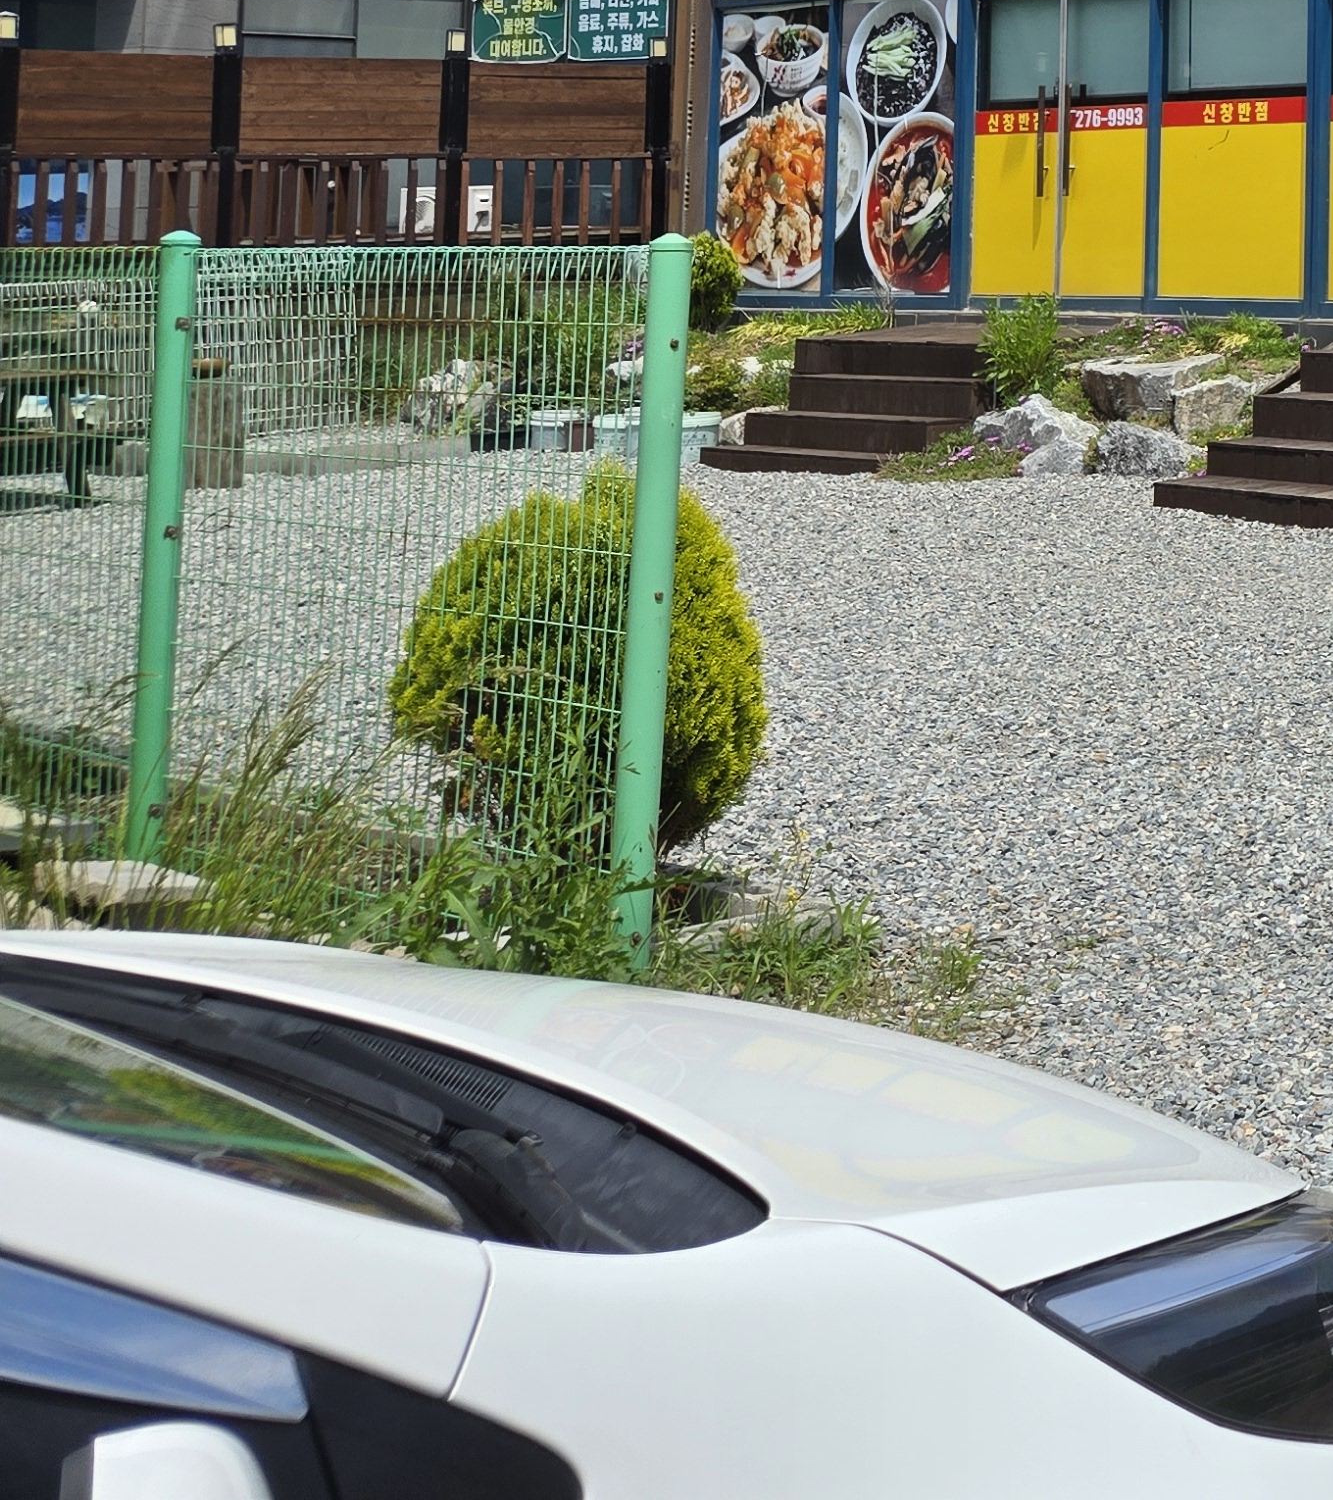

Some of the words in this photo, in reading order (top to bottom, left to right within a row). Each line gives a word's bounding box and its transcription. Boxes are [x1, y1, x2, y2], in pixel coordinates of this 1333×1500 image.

[503, 17, 536, 36] 물안경
[578, 13, 604, 33] 음료,
[607, 12, 634, 32] 주류,
[636, 11, 660, 29] 가스
[489, 38, 547, 58] 대여합니다.
[591, 35, 618, 54] 휴지,
[620, 33, 645, 52] 잡화
[1075, 107, 1144, 128] 276-9993
[1202, 101, 1269, 124] 신창반점
